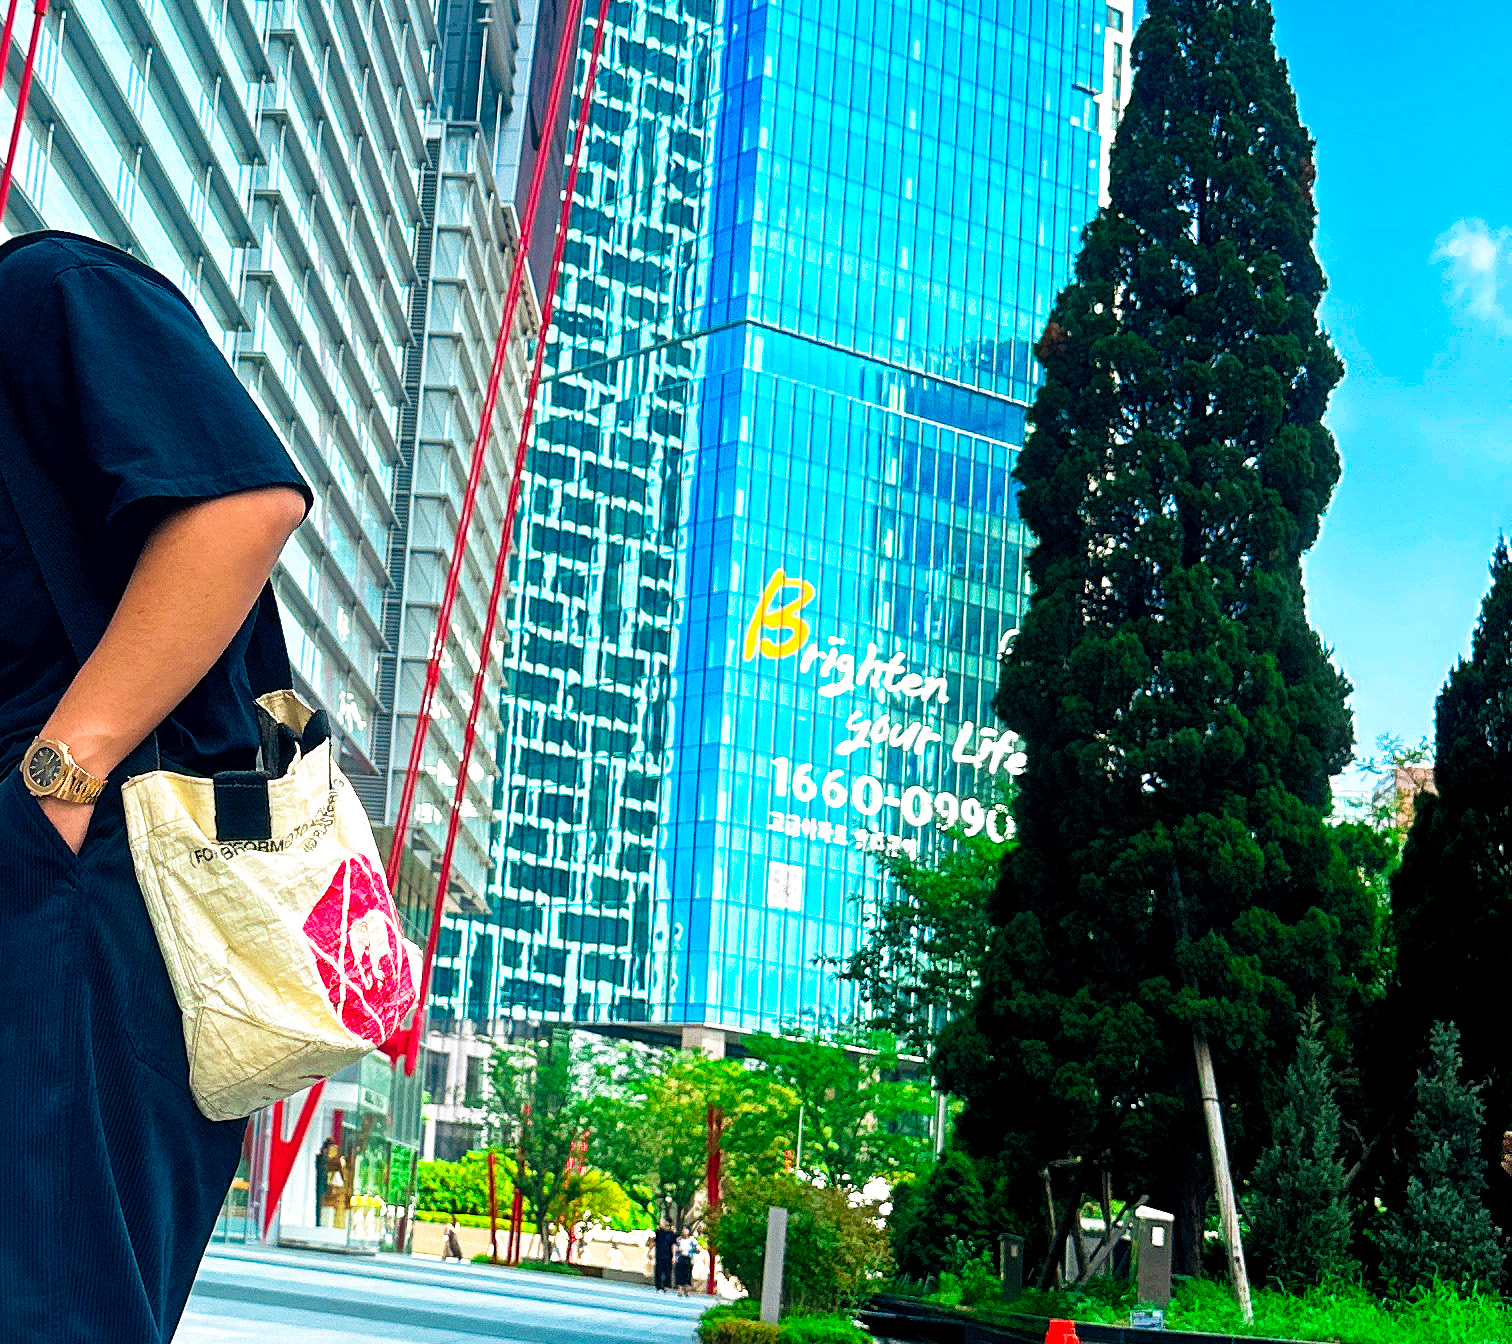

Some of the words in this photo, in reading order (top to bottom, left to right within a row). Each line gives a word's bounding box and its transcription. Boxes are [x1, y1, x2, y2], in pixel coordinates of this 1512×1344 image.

[743, 568, 950, 704] Brighten
[835, 709, 942, 756] your
[951, 720, 1028, 776] Life
[771, 756, 1016, 843] 1660-0990
